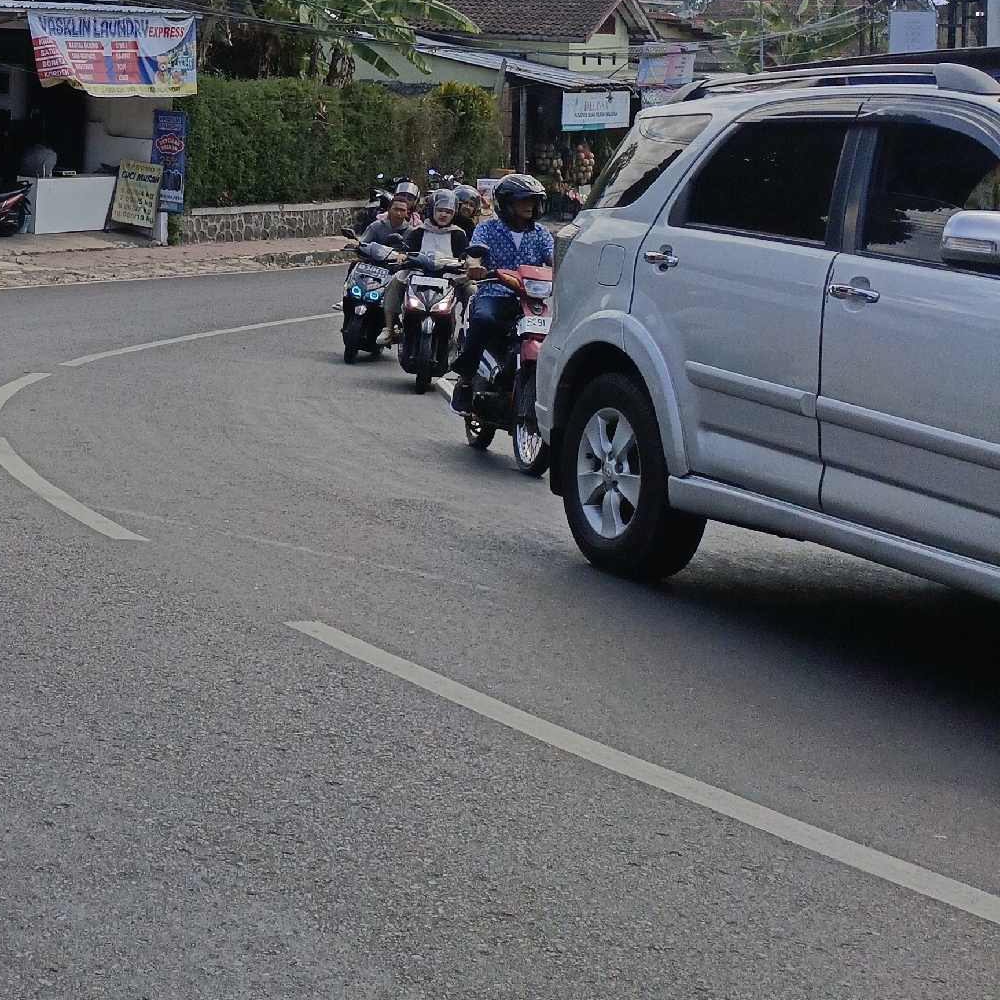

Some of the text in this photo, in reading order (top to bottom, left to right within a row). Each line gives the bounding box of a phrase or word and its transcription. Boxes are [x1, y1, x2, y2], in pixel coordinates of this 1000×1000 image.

[93, 17, 150, 39] LAUNDRY
[148, 25, 185, 39] EXPRESS
[159, 155, 180, 168] 25%
[121, 170, 161, 184] CUCI MURAH
